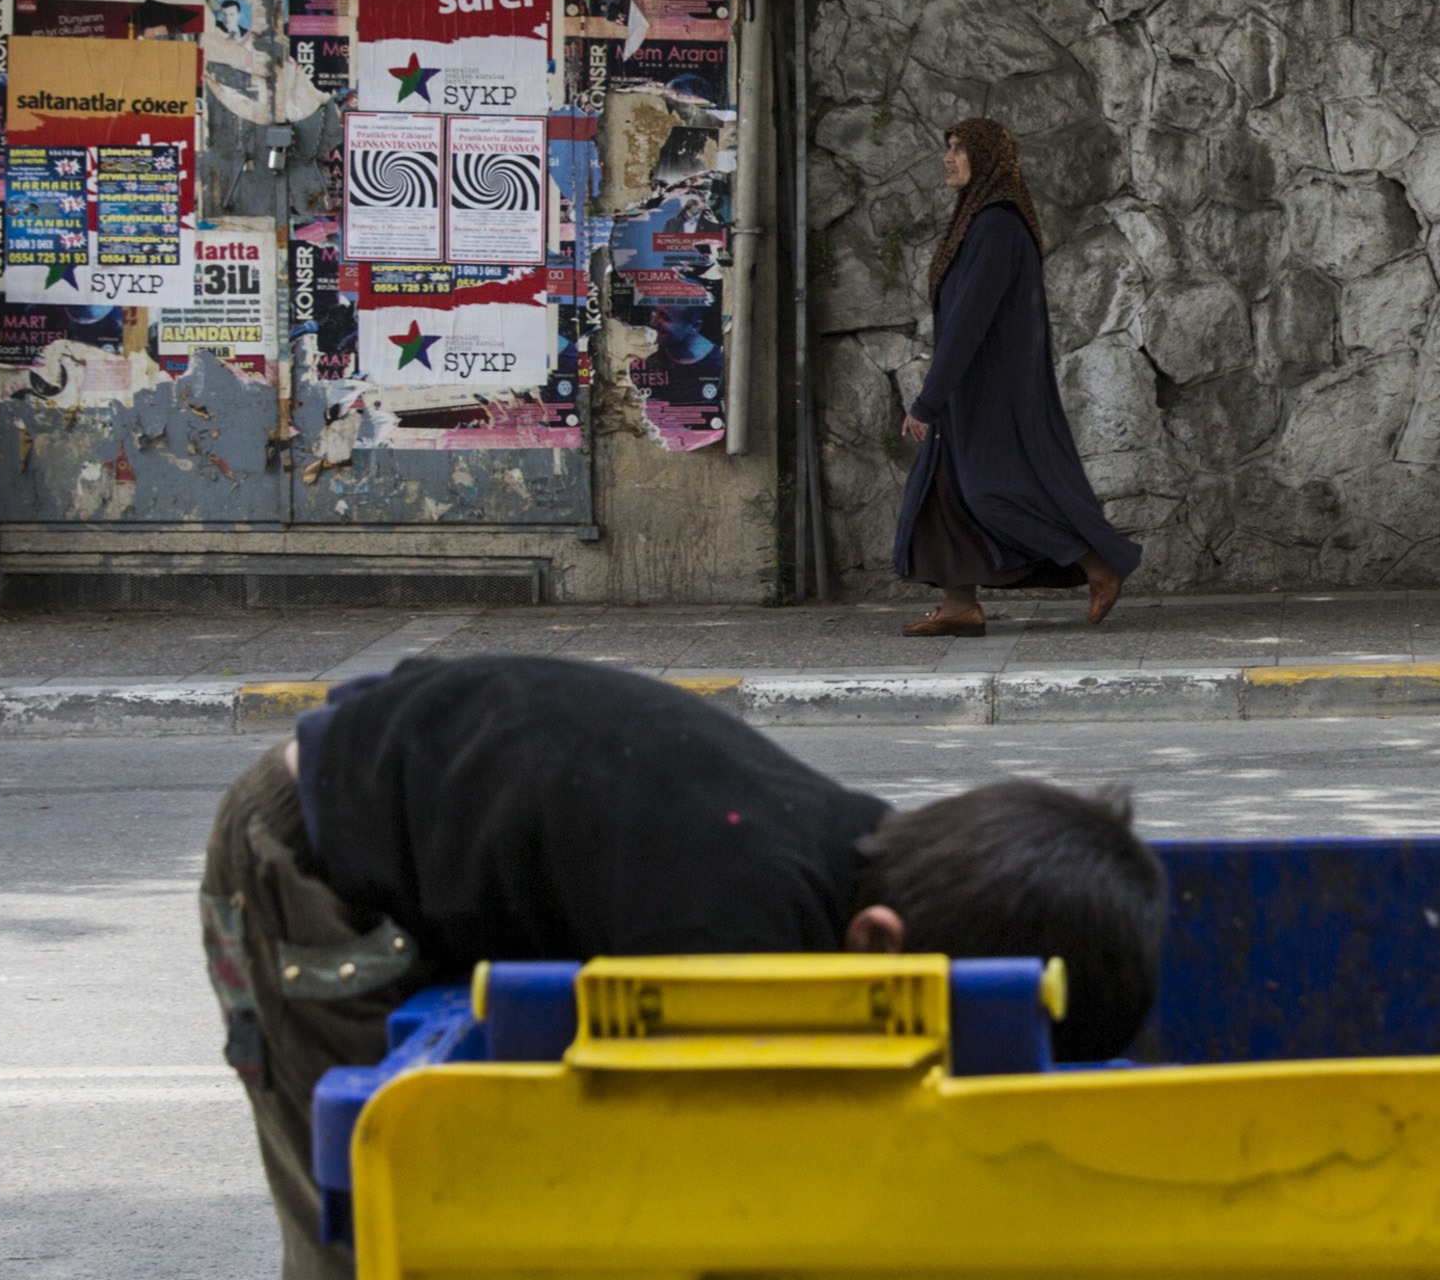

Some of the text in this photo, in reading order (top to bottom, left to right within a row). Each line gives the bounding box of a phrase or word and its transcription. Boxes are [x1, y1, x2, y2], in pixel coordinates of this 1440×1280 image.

[322, 41, 349, 57] Me
[667, 45, 725, 63] Ararat
[17, 91, 125, 112] saltanatlar
[350, 140, 438, 150] KONSANTRASYON
[452, 142, 541, 153] KONSANTRASYON
[11, 180, 82, 191] MARMARİS
[11, 217, 83, 228] İSTANBUL
[37, 252, 56, 263] 725
[59, 252, 71, 263] 31
[74, 252, 88, 263] 93
[637, 271, 672, 281] CUMA
[296, 246, 314, 320] KONSER
[402, 283, 420, 293] 725
[422, 283, 434, 293] 31
[3, 314, 47, 328] MART
[162, 325, 262, 342] ALANDAYIZ!
